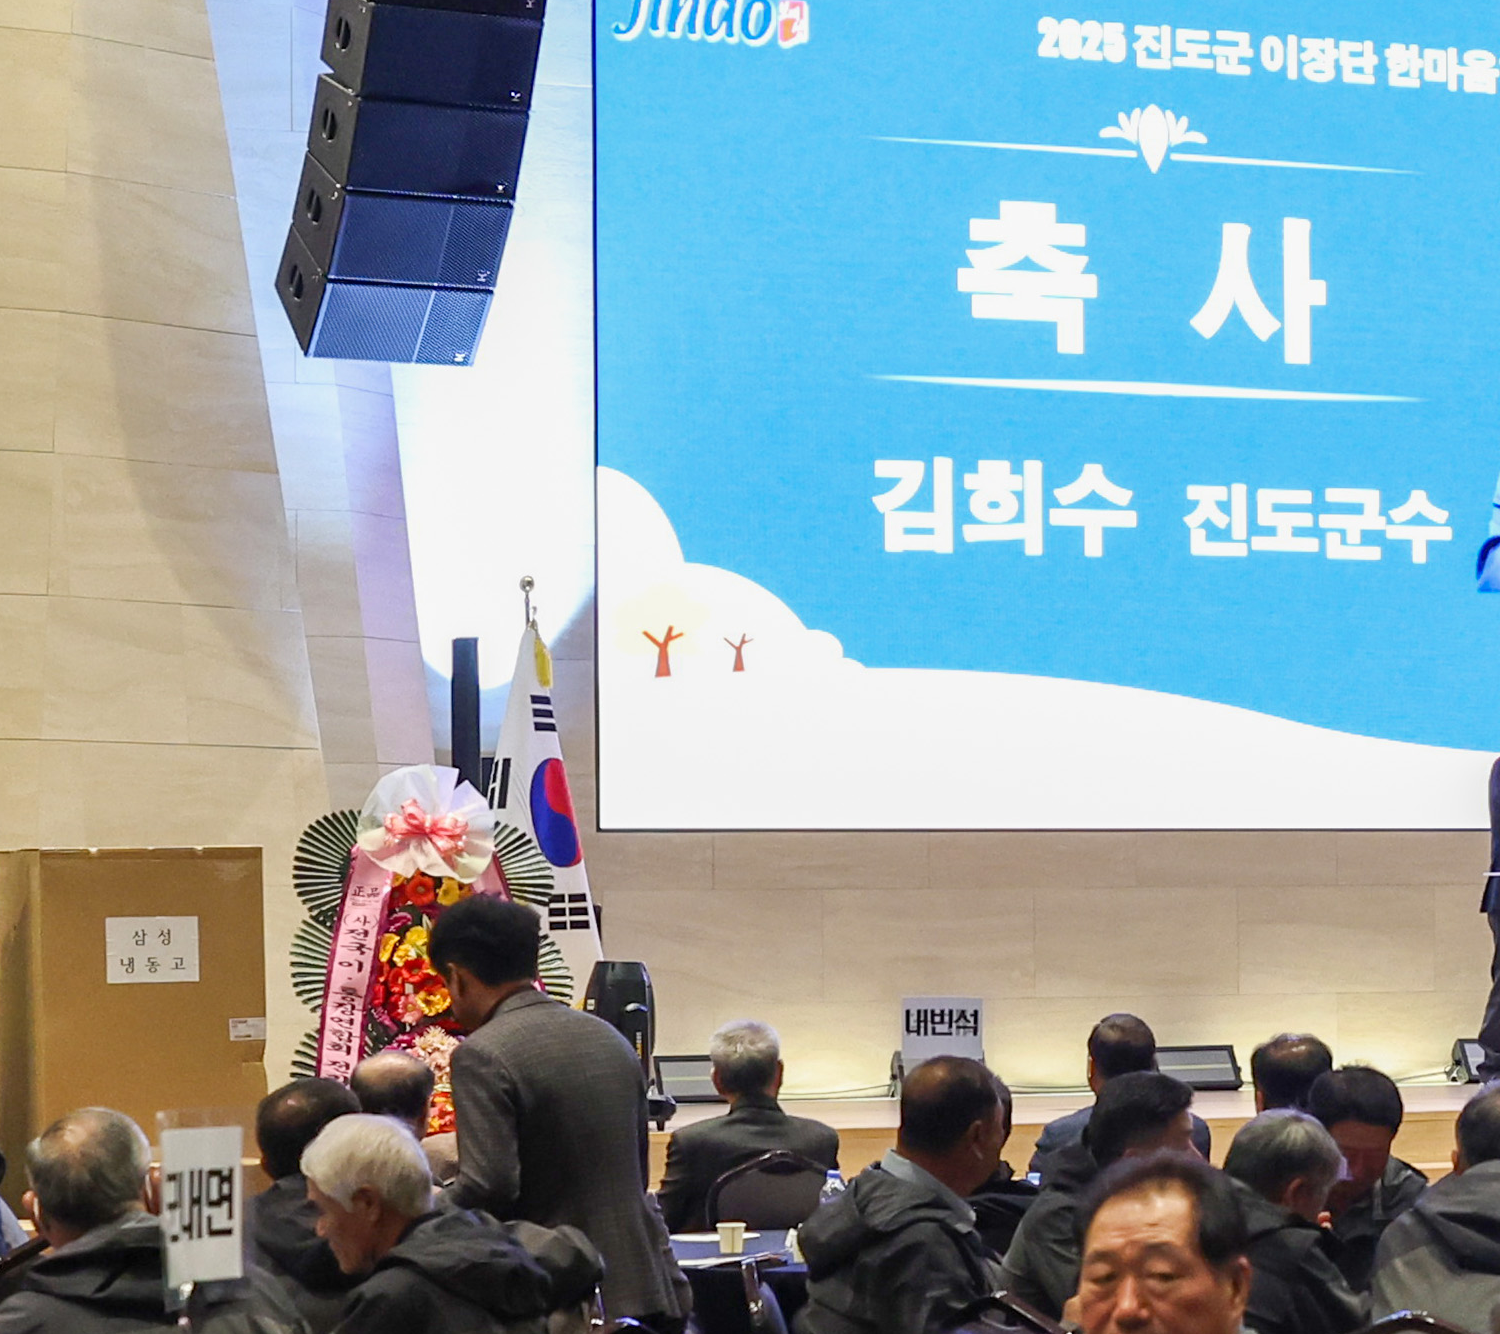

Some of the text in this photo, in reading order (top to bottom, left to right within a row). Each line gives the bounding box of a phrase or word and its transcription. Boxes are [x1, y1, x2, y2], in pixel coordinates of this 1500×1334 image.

[1037, 16, 1126, 63] 2025
[1133, 25, 1253, 75] 진도군
[1261, 34, 1377, 84] 이장단
[957, 199, 1326, 364] 축 사
[872, 455, 1452, 563] 김희수 진도군수
[905, 1008, 978, 1036] 내빈석
